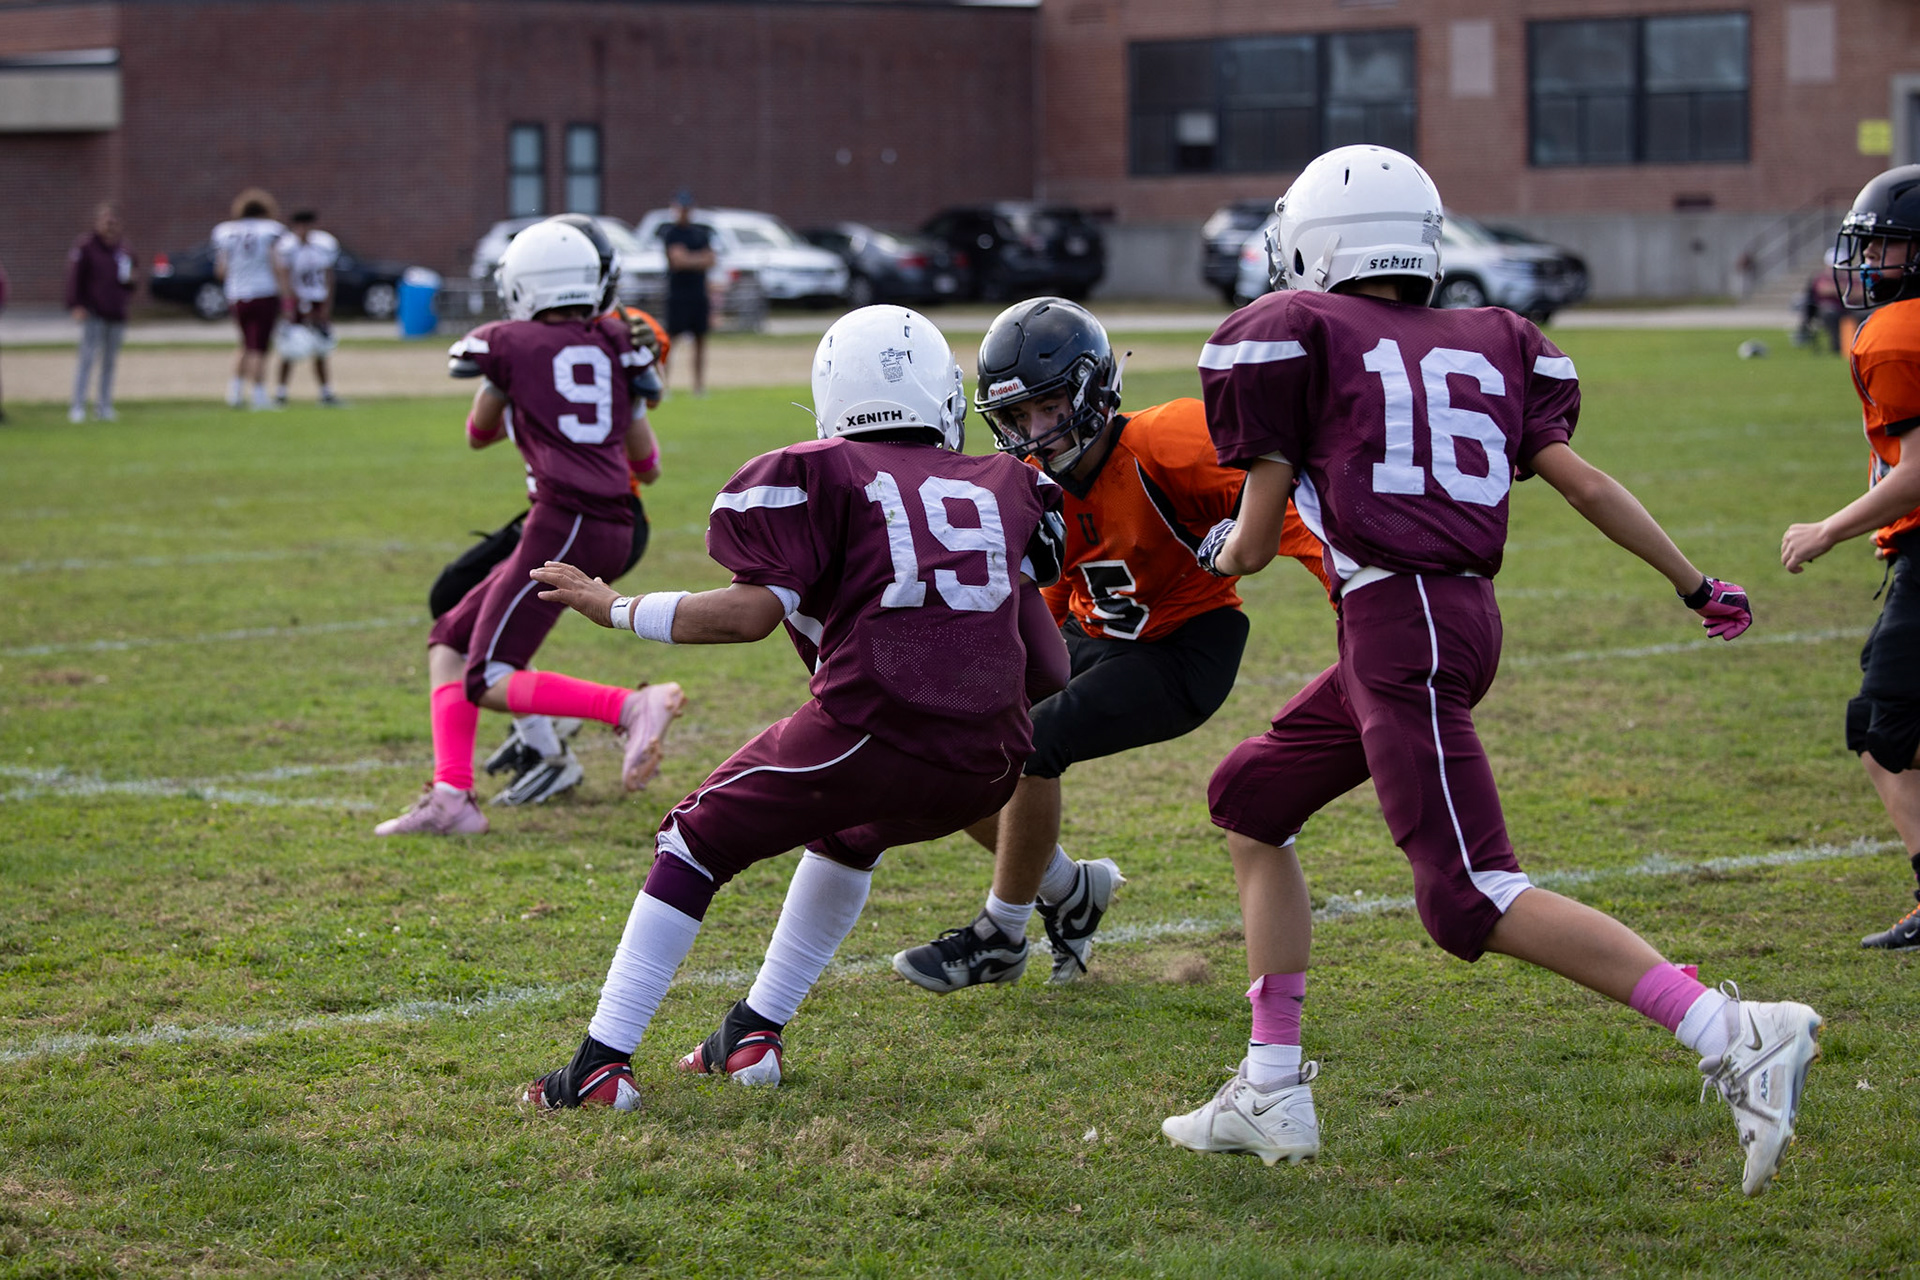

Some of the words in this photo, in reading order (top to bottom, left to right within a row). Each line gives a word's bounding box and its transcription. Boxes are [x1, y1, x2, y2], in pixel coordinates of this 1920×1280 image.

[552, 345, 613, 444] 9
[846, 410, 903, 427] XENITH
[990, 383, 1019, 397] Riddell
[1362, 338, 1510, 507] 16
[864, 471, 1012, 612] 19
[1078, 559, 1150, 640] 5
